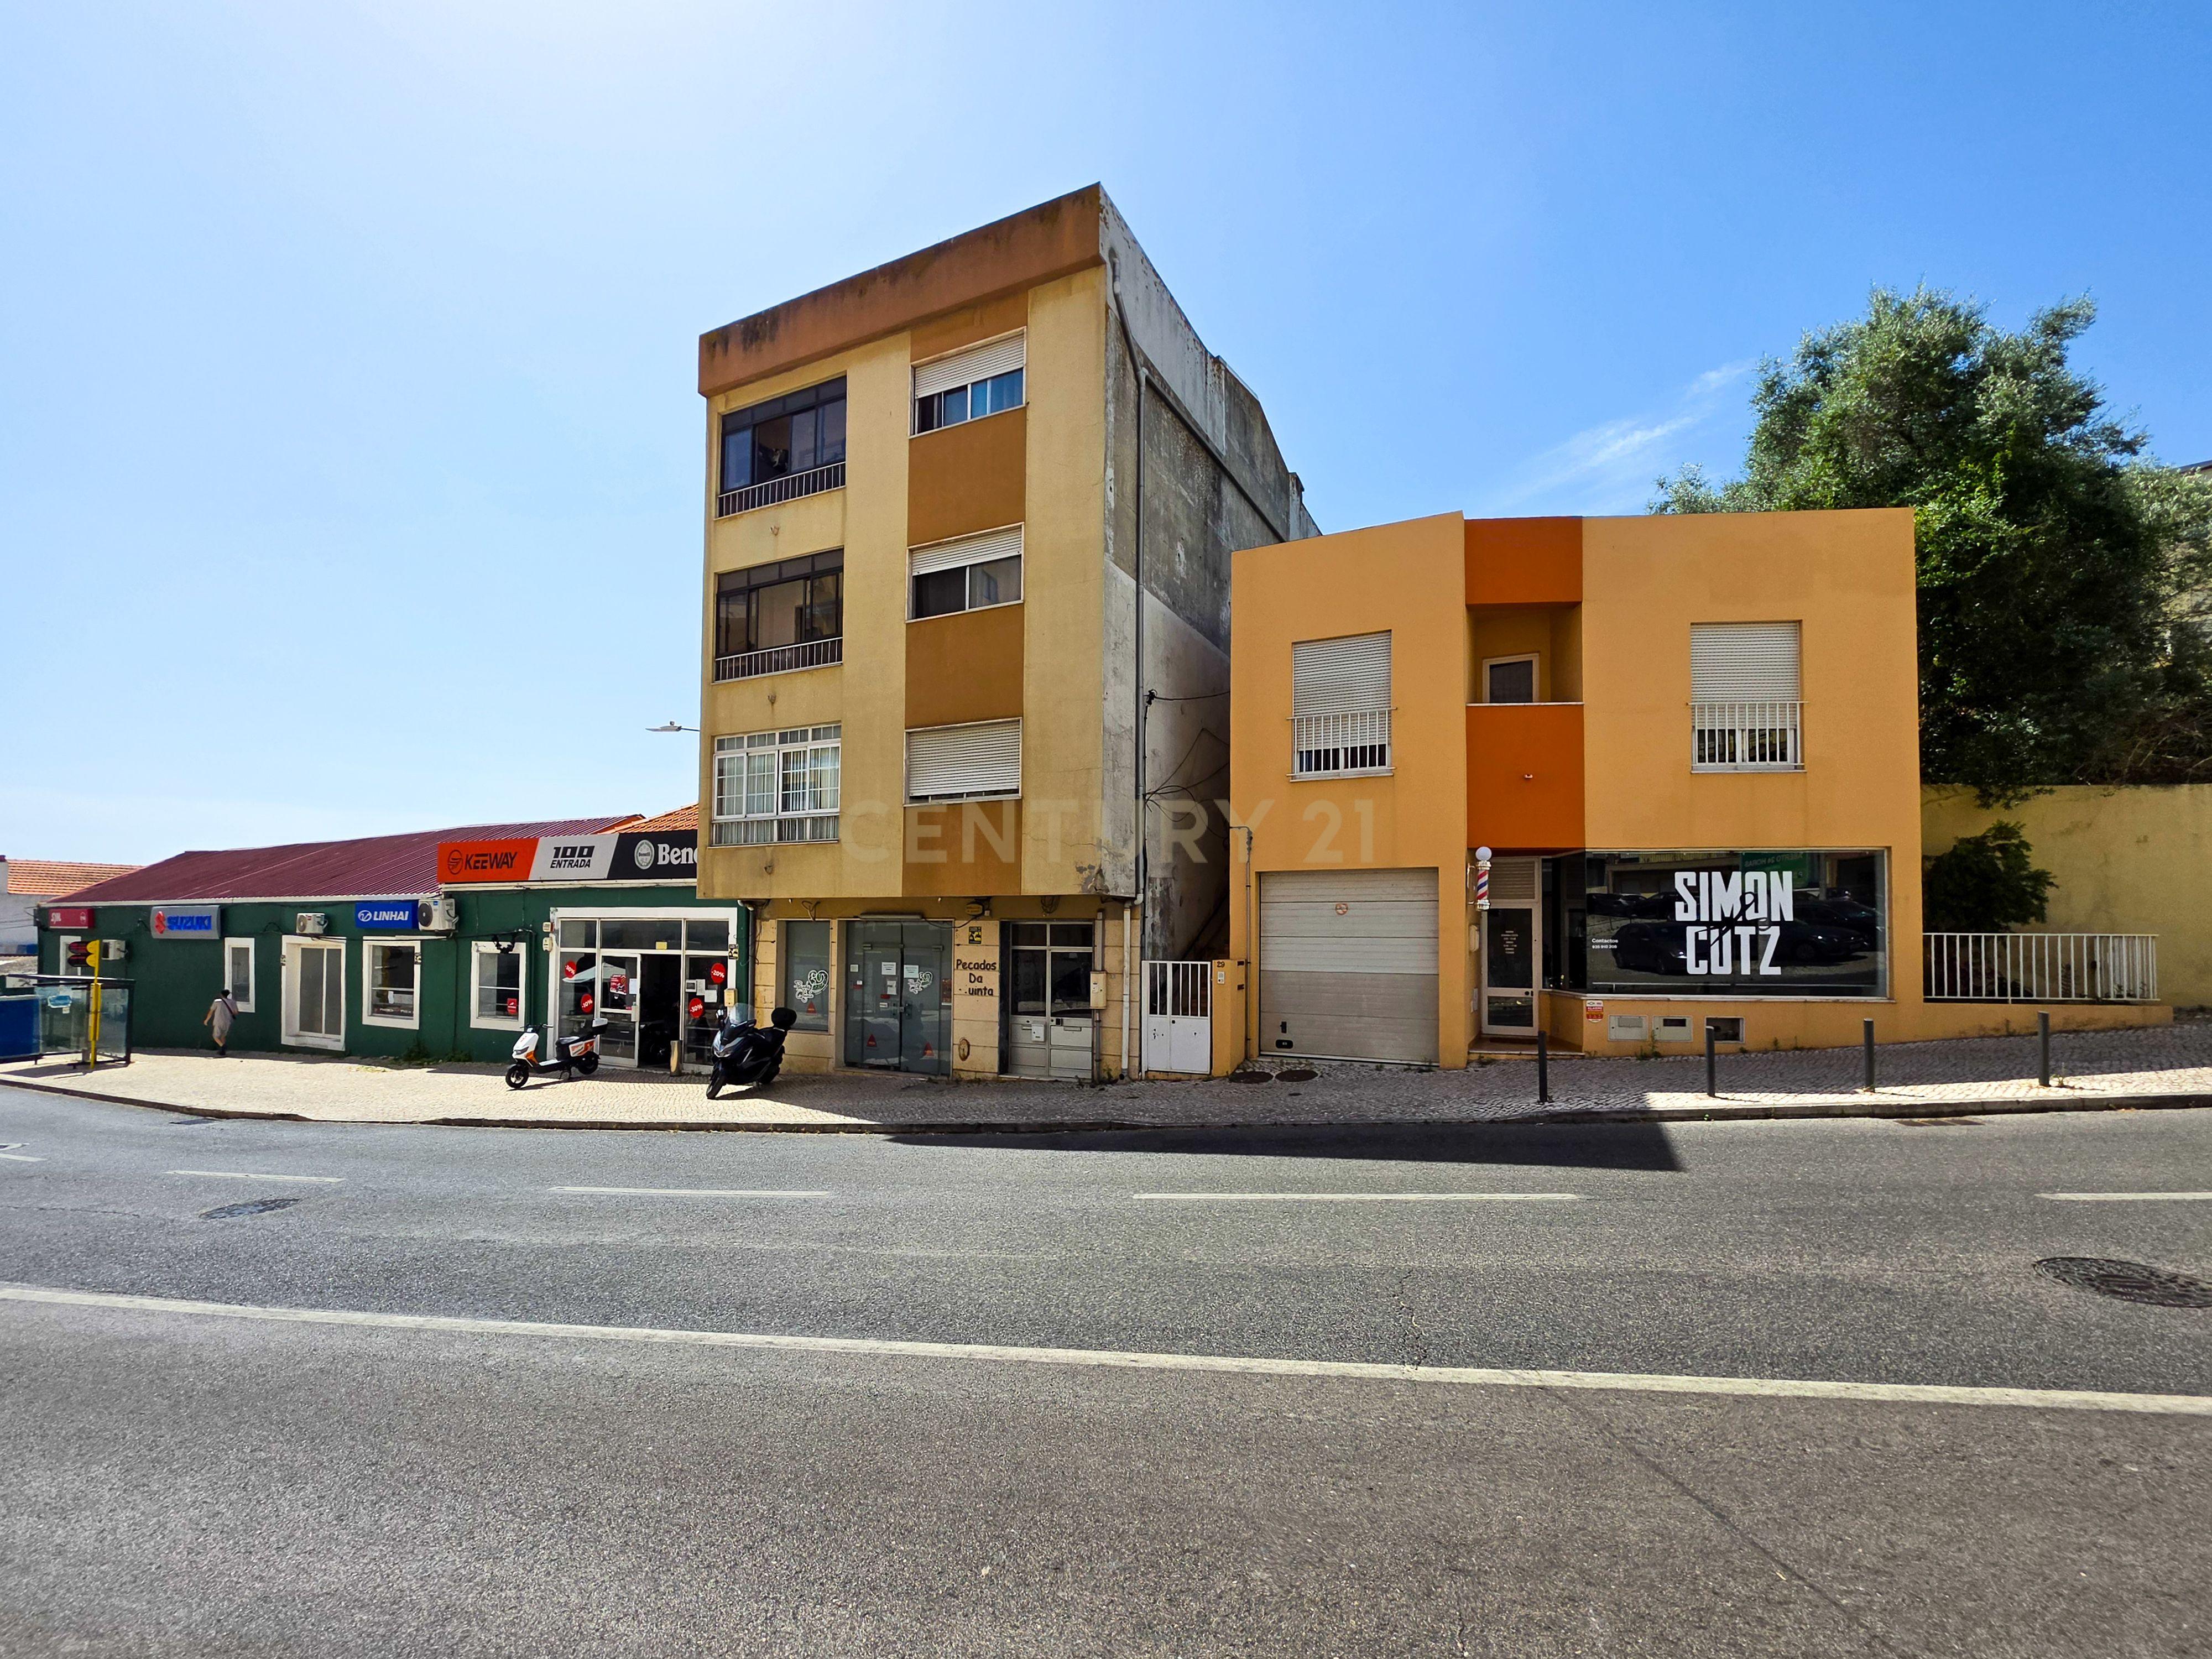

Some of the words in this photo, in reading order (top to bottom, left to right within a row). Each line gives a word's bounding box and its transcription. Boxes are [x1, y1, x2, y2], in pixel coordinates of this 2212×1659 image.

[554, 846, 595, 858] 100
[465, 852, 518, 870] KEEWAY
[550, 859, 591, 868] ENTRADA
[1674, 871, 1793, 921] SIMON
[373, 911, 409, 921] LINHAI
[167, 915, 212, 931] SUZUKI
[1686, 926, 1782, 975] CUTZ
[956, 959, 997, 971] Pecados
[711, 970, 725, 978] -20%
[969, 973, 983, 983] Da
[968, 986, 994, 996] uinta
[581, 999, 593, 1008] -10%
[689, 1004, 703, 1013] -30%
